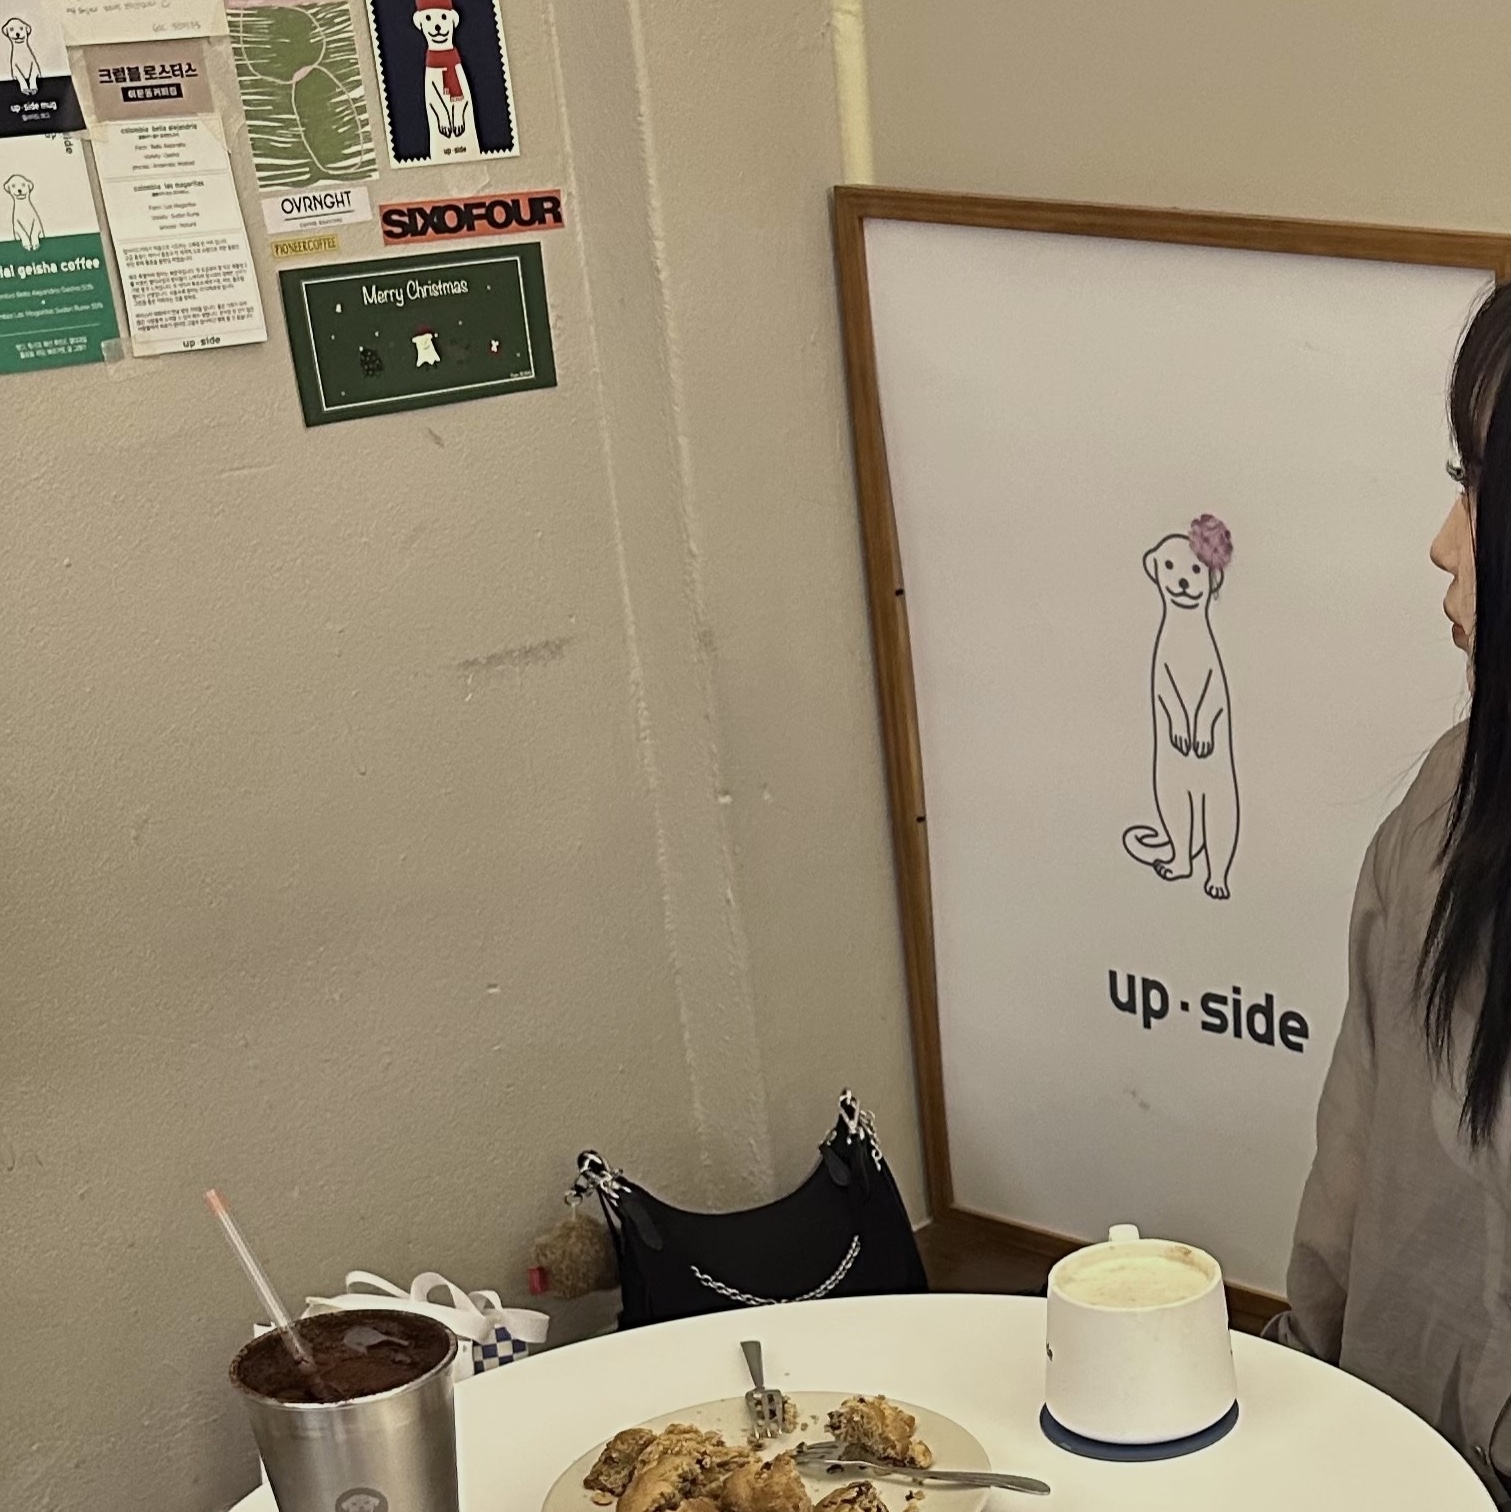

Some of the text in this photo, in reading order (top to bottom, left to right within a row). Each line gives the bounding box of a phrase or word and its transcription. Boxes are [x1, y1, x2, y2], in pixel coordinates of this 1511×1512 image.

[98, 62, 199, 84] 크럼블 로스터스
[280, 190, 352, 215] OVRNGHT
[382, 195, 564, 240] SIXOFOUR
[17, 261, 58, 280] geisha
[60, 257, 100, 272] coffee
[361, 279, 469, 307] Merry Christmas
